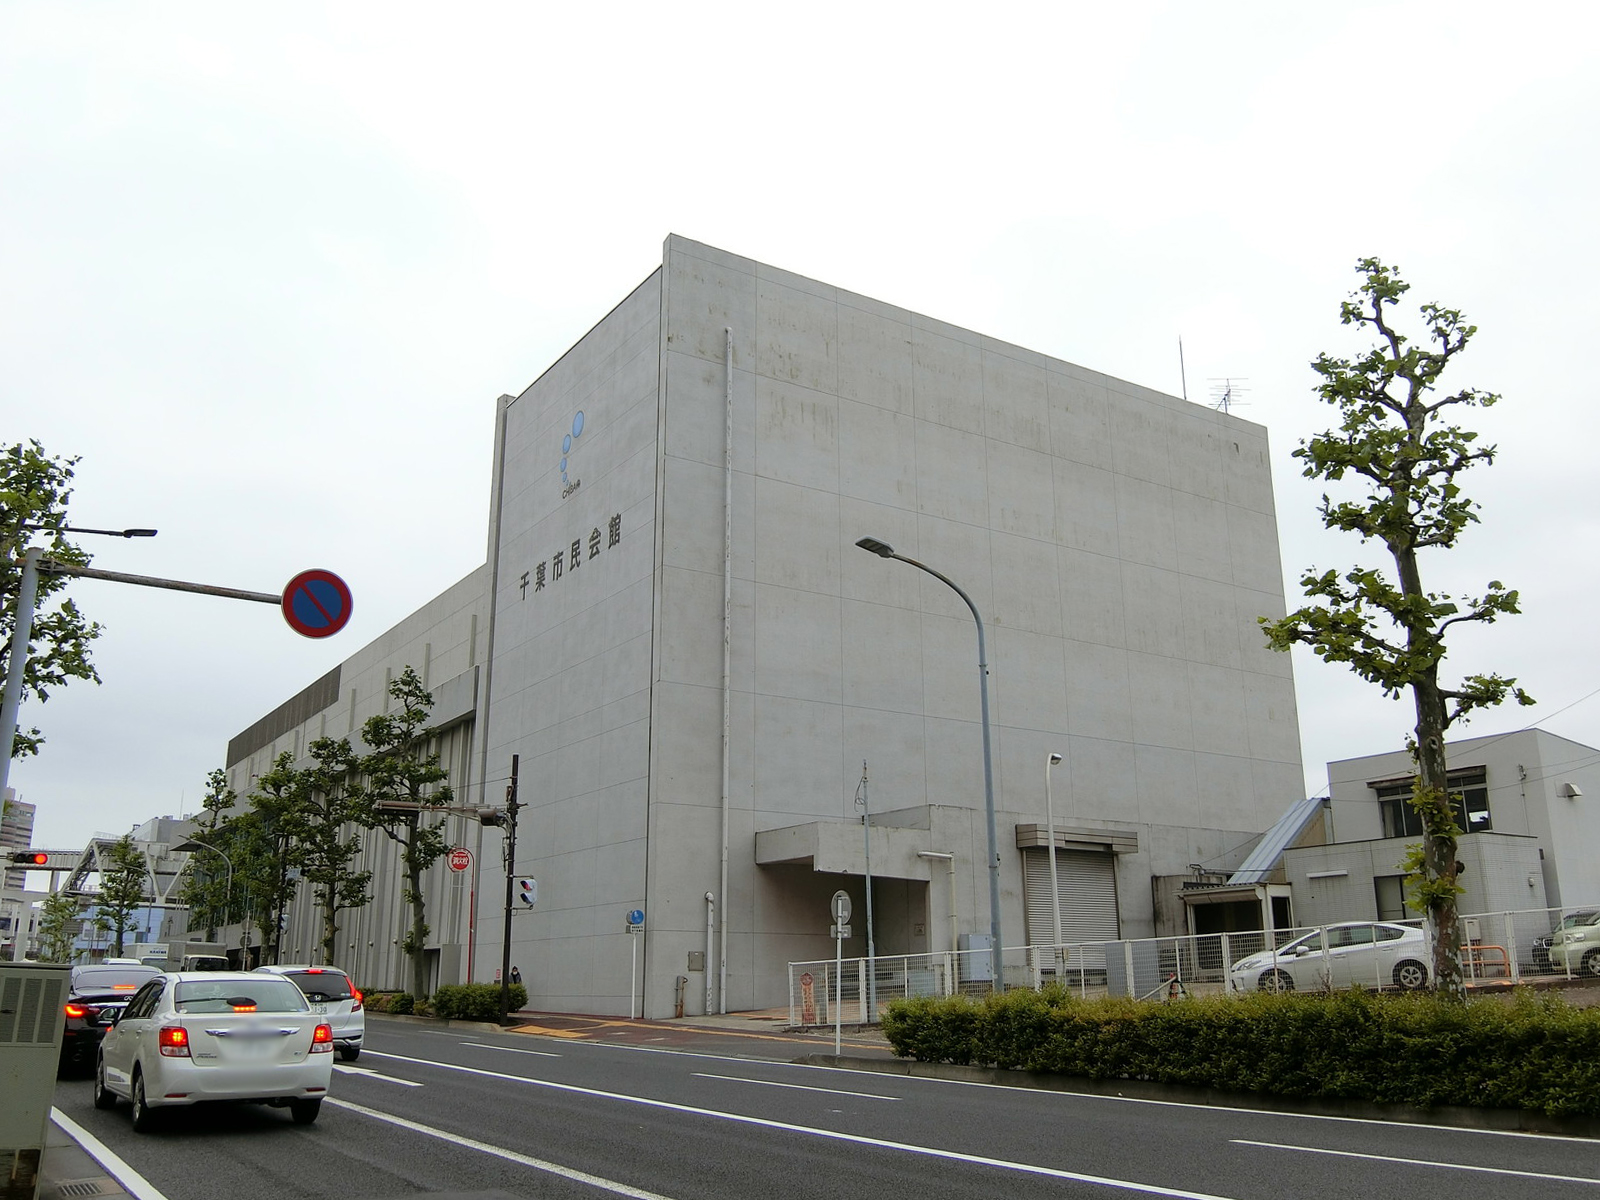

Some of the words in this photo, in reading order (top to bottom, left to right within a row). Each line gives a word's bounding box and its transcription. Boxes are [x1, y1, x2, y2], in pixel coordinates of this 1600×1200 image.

[520, 513, 621, 601] 千葉市民会館
